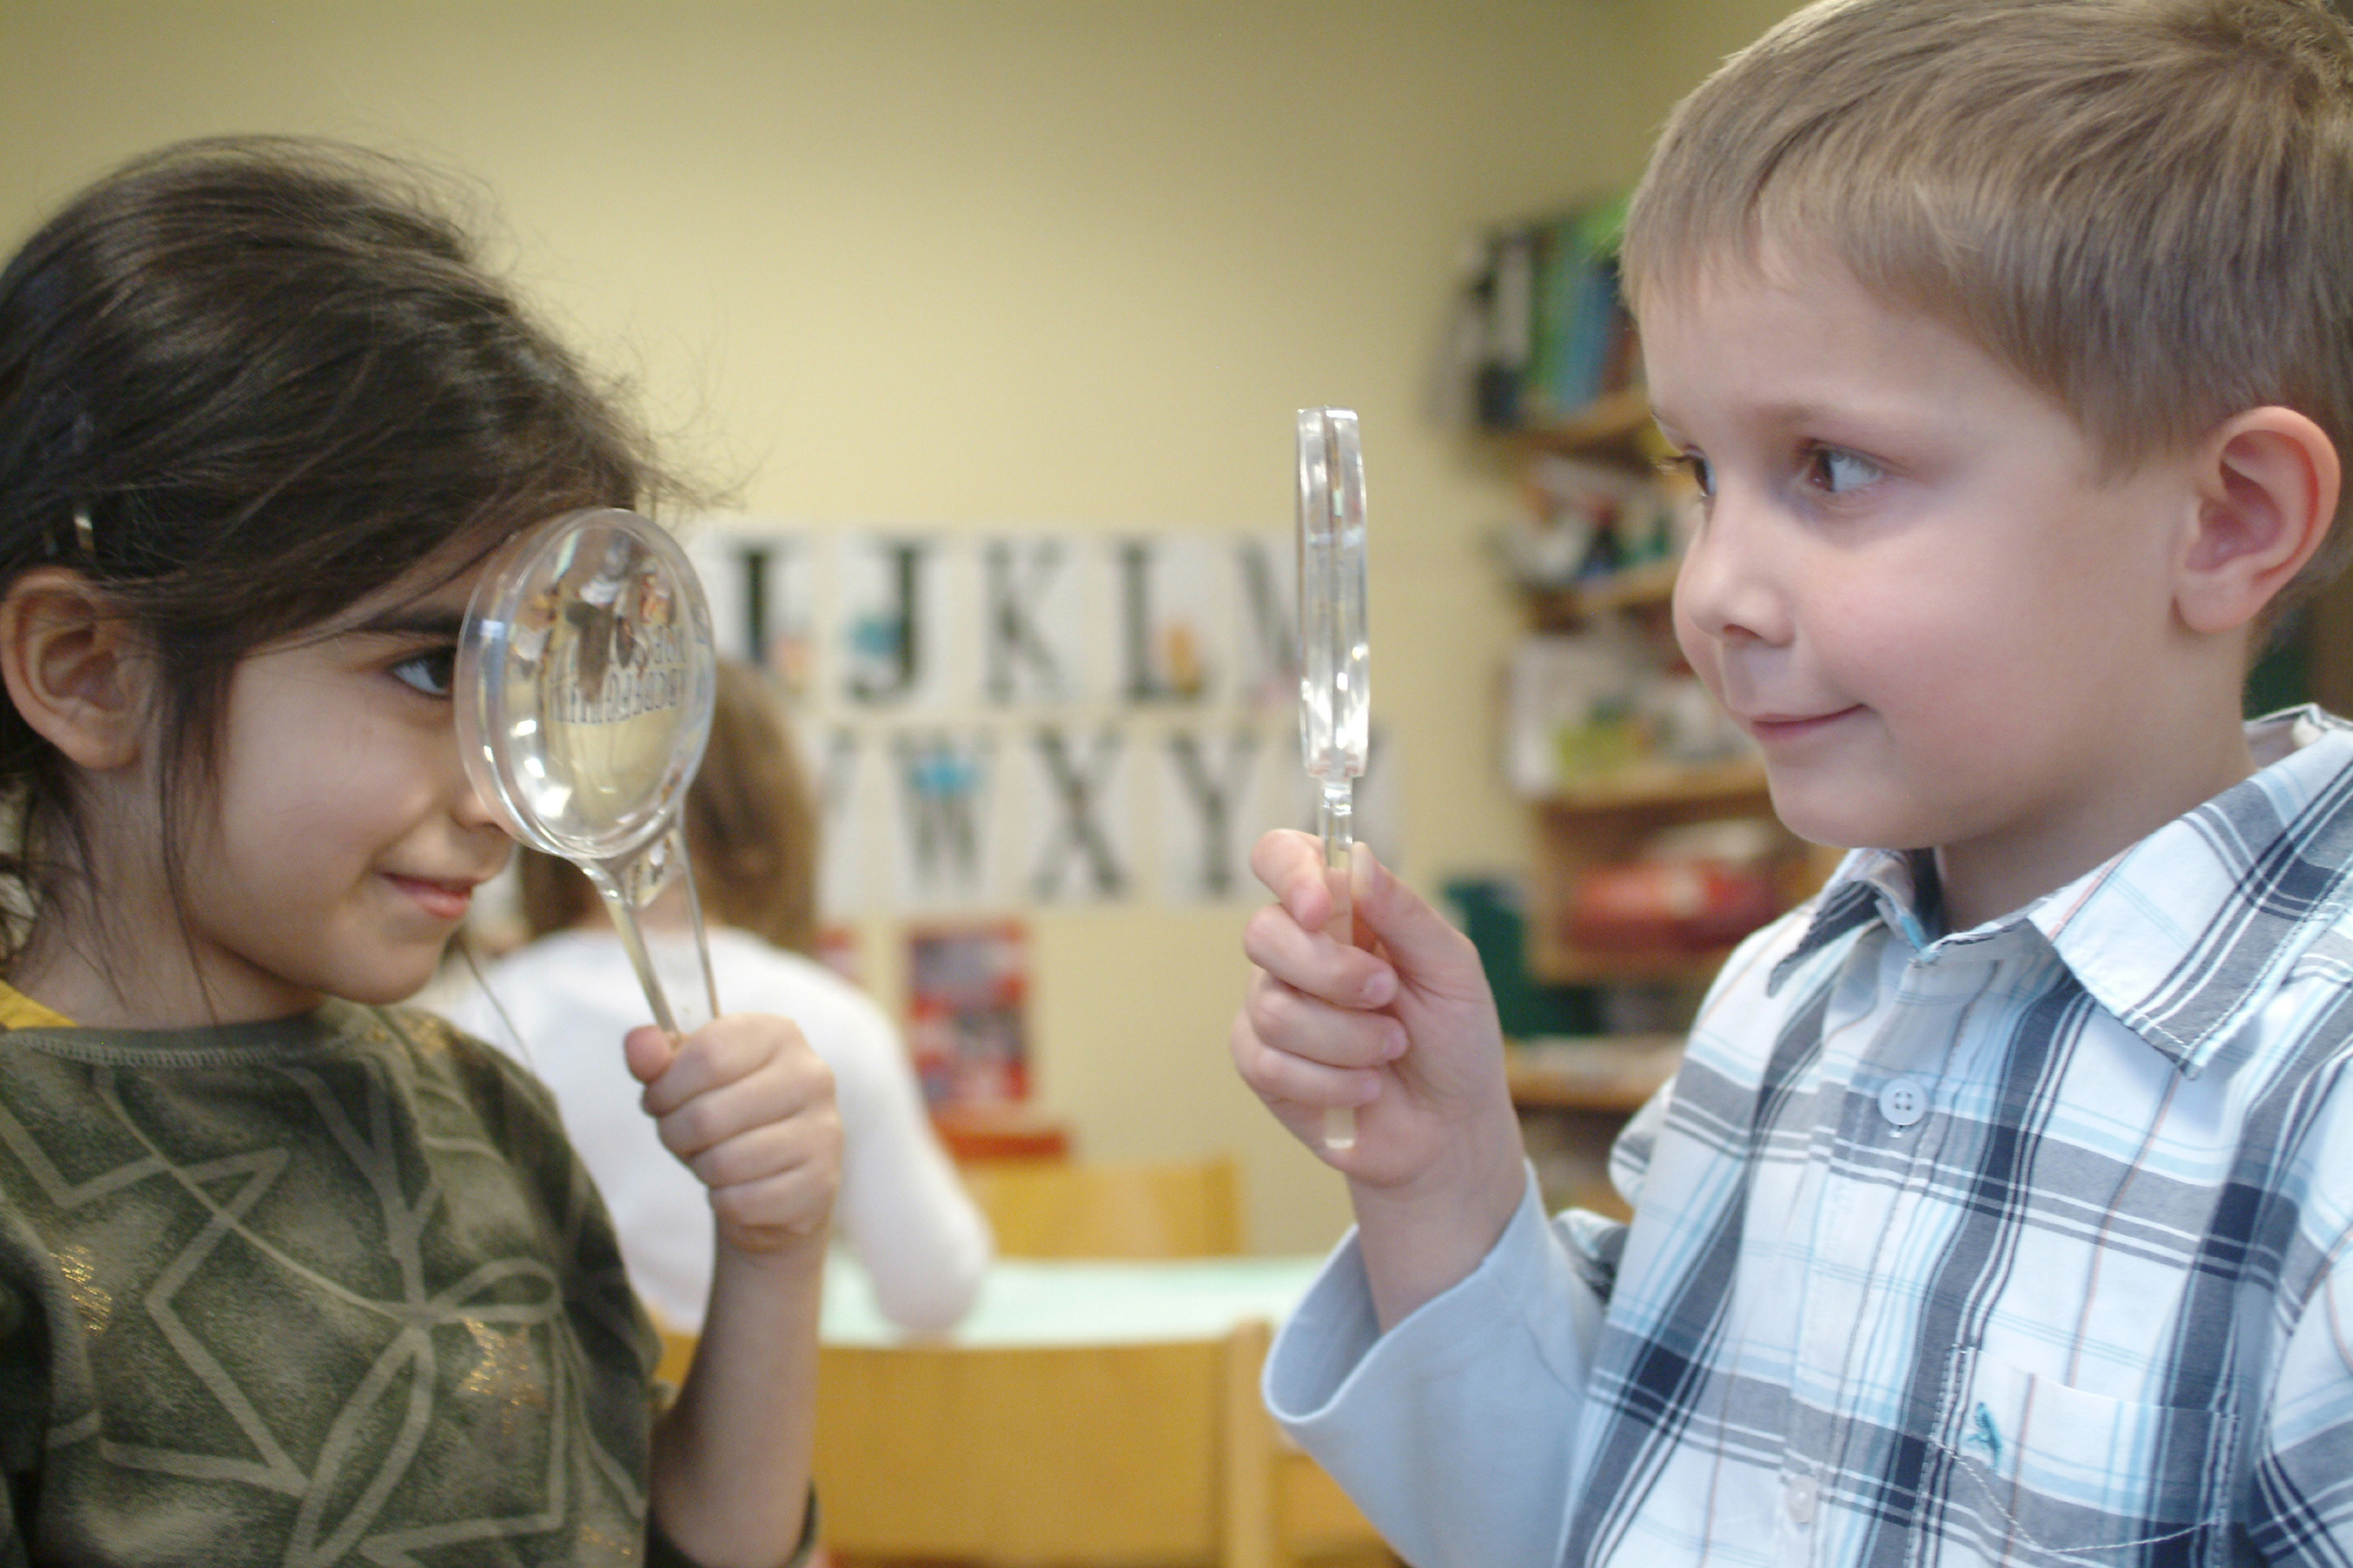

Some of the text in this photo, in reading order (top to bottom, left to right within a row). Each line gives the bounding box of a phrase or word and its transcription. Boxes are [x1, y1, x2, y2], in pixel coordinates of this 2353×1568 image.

[844, 534, 943, 707] J
[979, 535, 1066, 707] K
[1111, 533, 1214, 708] L
[1028, 721, 1129, 900] X
[1165, 724, 1266, 899] Y
